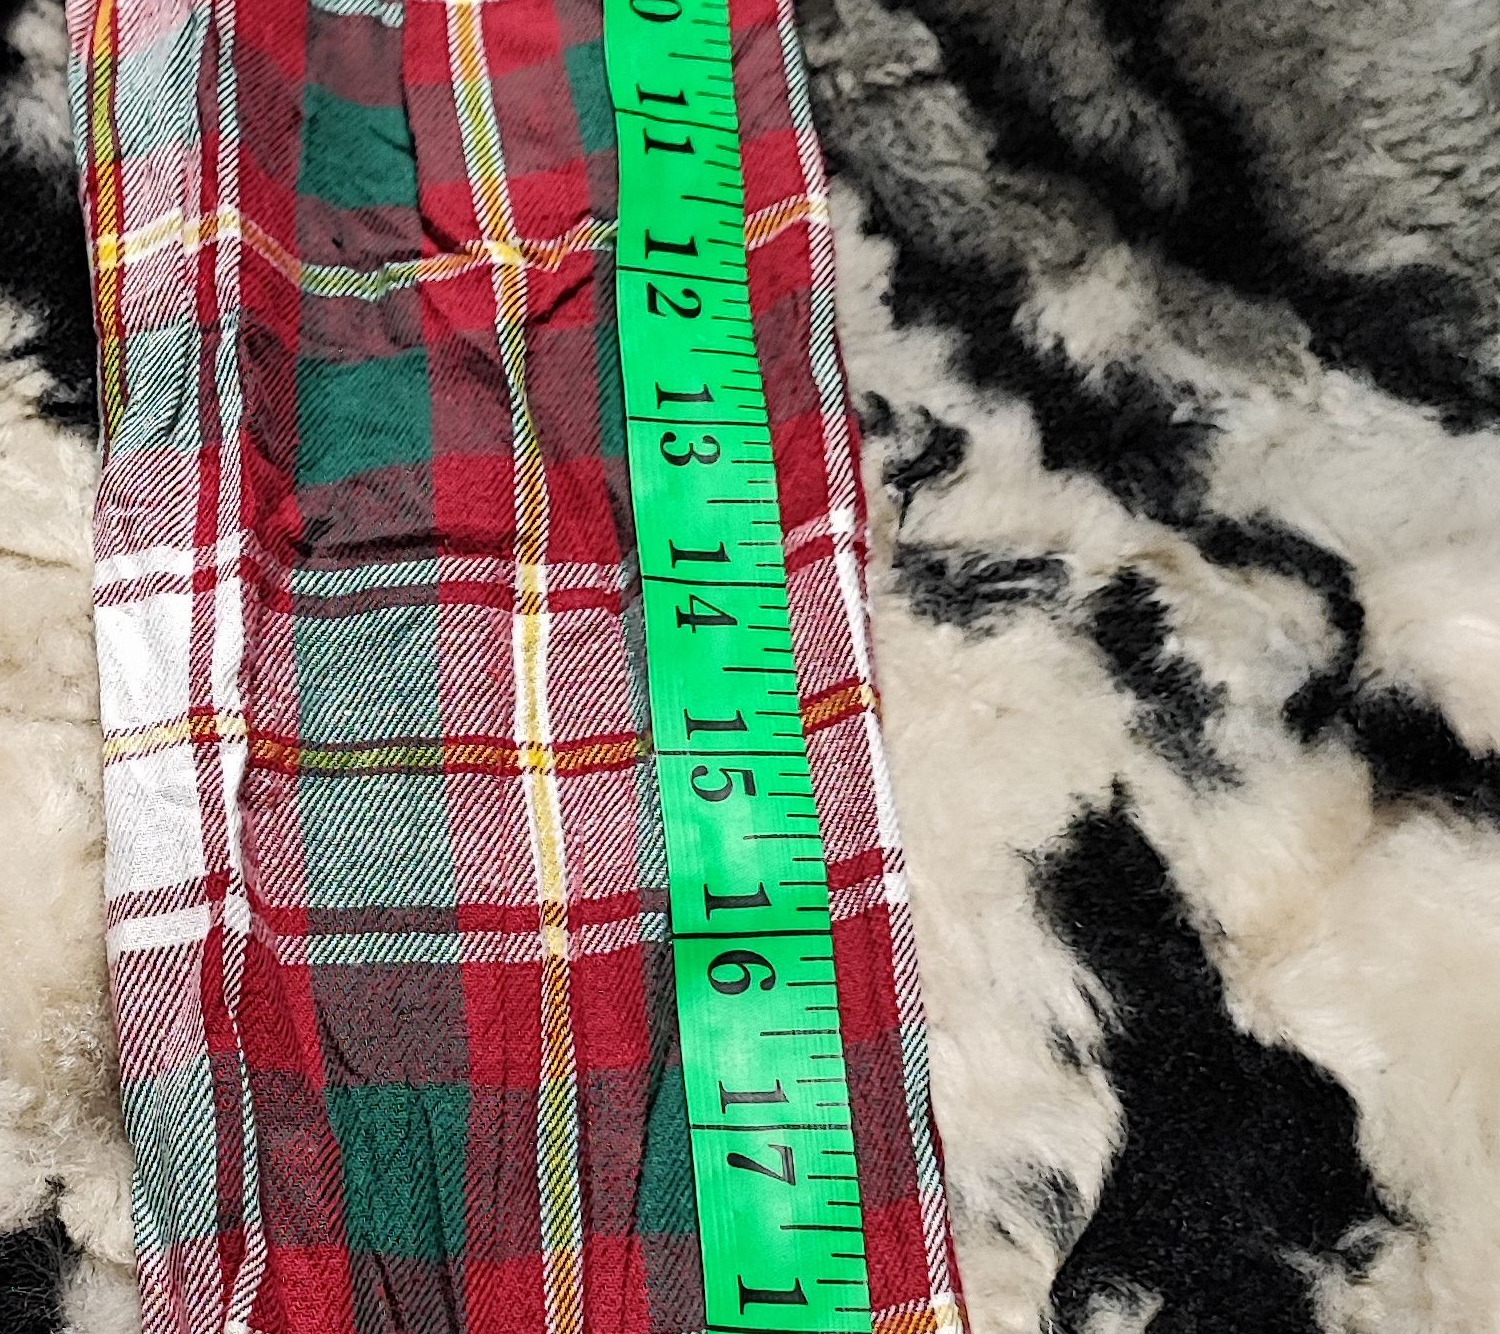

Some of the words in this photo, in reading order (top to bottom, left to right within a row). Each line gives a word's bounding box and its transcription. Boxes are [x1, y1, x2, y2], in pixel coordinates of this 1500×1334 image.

[635, 82, 696, 155] 11
[644, 228, 703, 319] 12
[654, 381, 721, 467] 13
[668, 538, 738, 634] 14
[683, 708, 756, 803] 15
[703, 882, 777, 996] 16
[717, 1078, 796, 1186] 17
